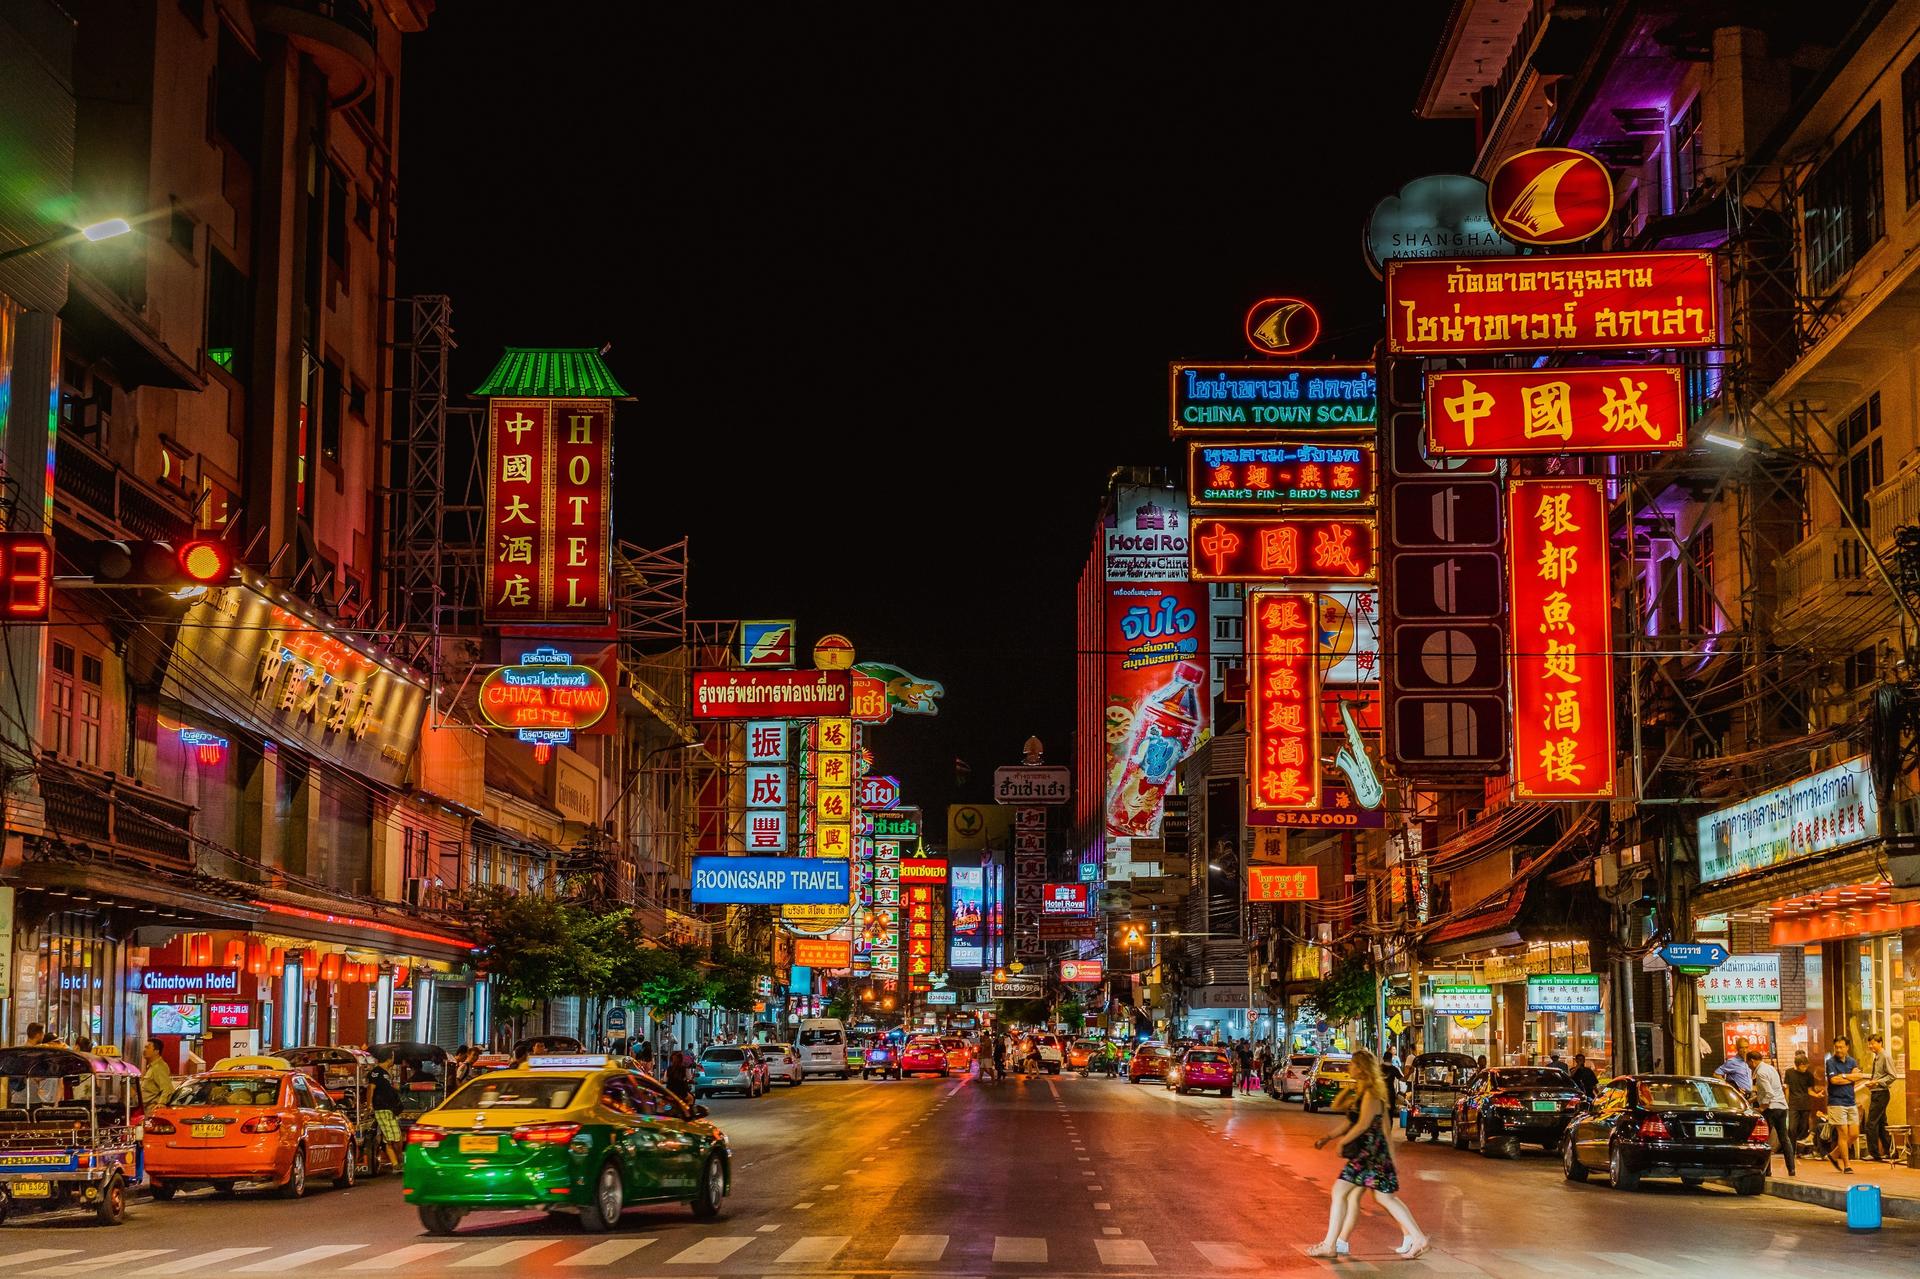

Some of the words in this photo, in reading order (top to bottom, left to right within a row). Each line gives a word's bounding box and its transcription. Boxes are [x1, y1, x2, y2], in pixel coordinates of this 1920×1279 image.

[1447, 265, 1653, 297] ภัตตาคารหูฉลาม
[1402, 300, 1577, 342] ไชน่าทาวน์
[1595, 296, 1704, 338] สกาล่า
[1185, 371, 1299, 399] ไชน่าทาวน์
[1184, 406, 1246, 423] CHINA
[1252, 406, 1311, 422] TOWN
[1444, 378, 1661, 446] 中國城
[1204, 489, 1252, 498] SHARK'S
[1289, 489, 1327, 498] BIRD'S
[1331, 489, 1360, 498] NEST
[498, 412, 536, 607] 中國大酒店
[567, 415, 593, 608] HOTEL
[1110, 534, 1158, 551] Hotel
[1201, 523, 1359, 576] 中國城
[1121, 596, 1196, 640] จับใจ
[1129, 641, 1175, 656] สดชื่นจาก
[1534, 493, 1586, 786] 銀都魚翅酒樓
[488, 687, 543, 704] CHINA
[552, 688, 601, 706] TOWN
[699, 671, 845, 713] รุ่งทรัพย์การท่องเที่ยว
[1261, 601, 1309, 800] 銀都魚翅酒樓
[516, 708, 570, 723] HOTEL
[751, 727, 782, 847] 振成豐
[1276, 812, 1358, 825] SEAFOOD
[697, 870, 786, 890] ROONGSARP
[791, 870, 844, 890] TRAVEL
[1065, 900, 1086, 908] Royal
[1711, 948, 1719, 960] 2
[143, 972, 203, 989] Chinatown
[205, 971, 236, 989] Hotel
[210, 1005, 249, 1014] 中国大酒店
[393, 1006, 408, 1014] TEL
[221, 1016, 237, 1025] 欢迎
[95, 1047, 114, 1055] TAXI
